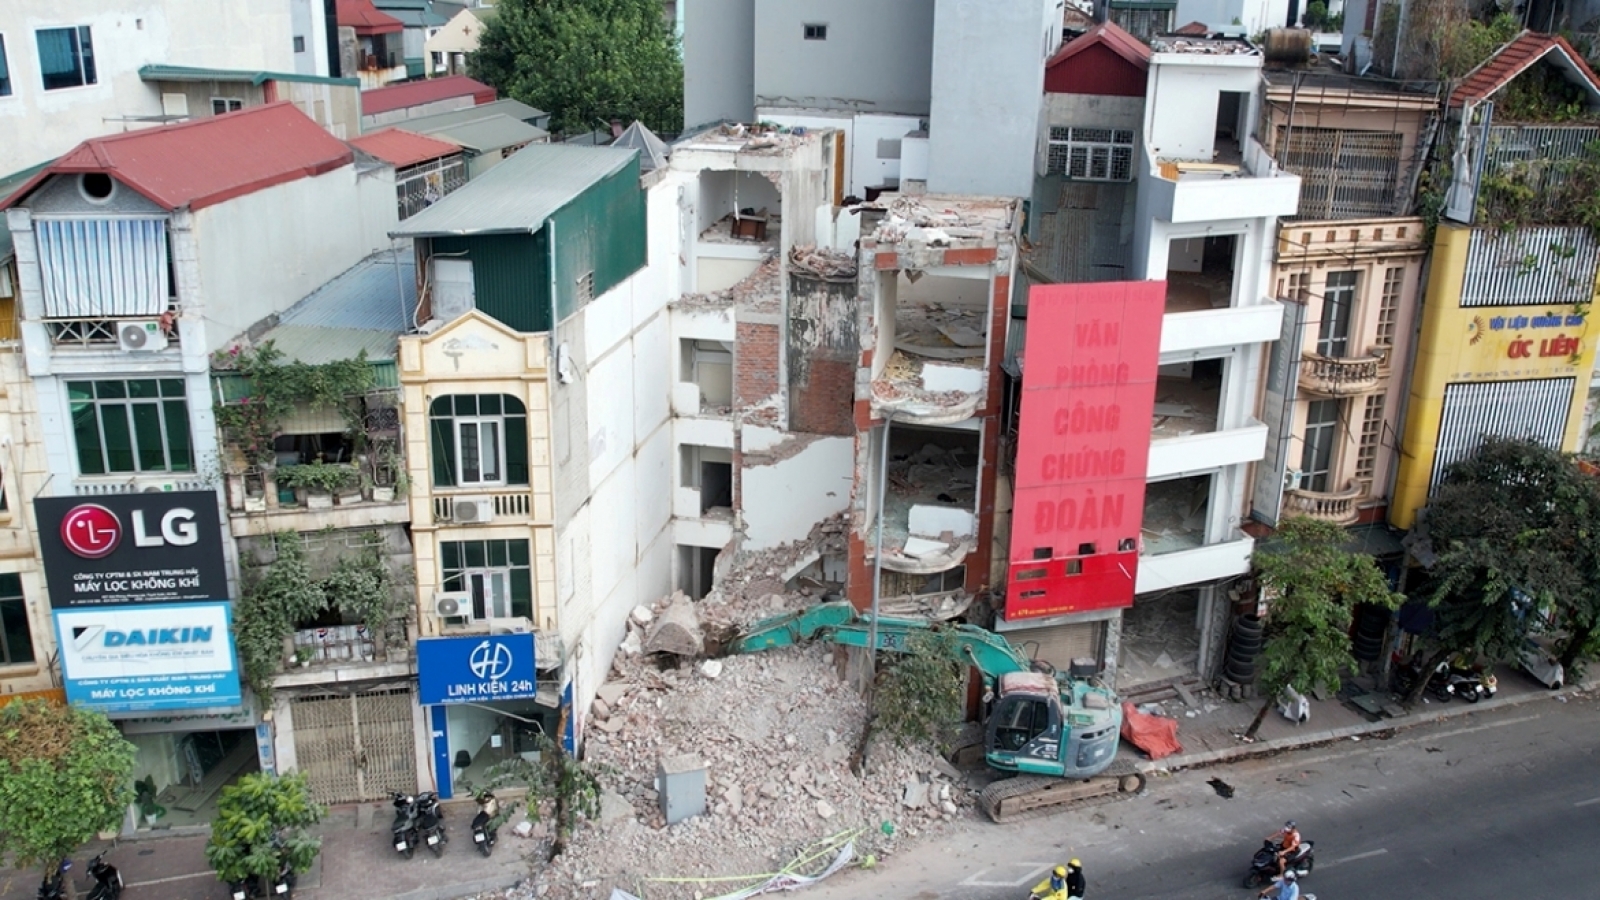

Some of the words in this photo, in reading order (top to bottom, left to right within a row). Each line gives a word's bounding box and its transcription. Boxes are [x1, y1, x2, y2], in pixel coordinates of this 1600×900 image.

[1075, 319, 1120, 347] VĂN
[1539, 333, 1580, 358] LIÊN
[1056, 362, 1129, 388] PHÒNG
[1053, 400, 1120, 435] CÔNG
[1041, 451, 1125, 481] CHỨNG
[1034, 488, 1125, 534] ĐOÀN
[131, 507, 198, 548] LG
[74, 572, 94, 581] CÔNG
[95, 572, 104, 580] TY
[74, 579, 101, 592] MÁY
[104, 580, 128, 592] LỌC
[131, 576, 176, 590] KHÔNG
[179, 574, 200, 588] KHÍ
[104, 625, 213, 648] DAIKIN
[91, 688, 116, 699] MÁY
[120, 688, 146, 700] LỌC
[148, 684, 192, 696] KHÔNG
[194, 682, 216, 694] KHÍ
[448, 684, 476, 696] LINH
[478, 678, 507, 696] KIỆN
[511, 680, 533, 692] 24h
